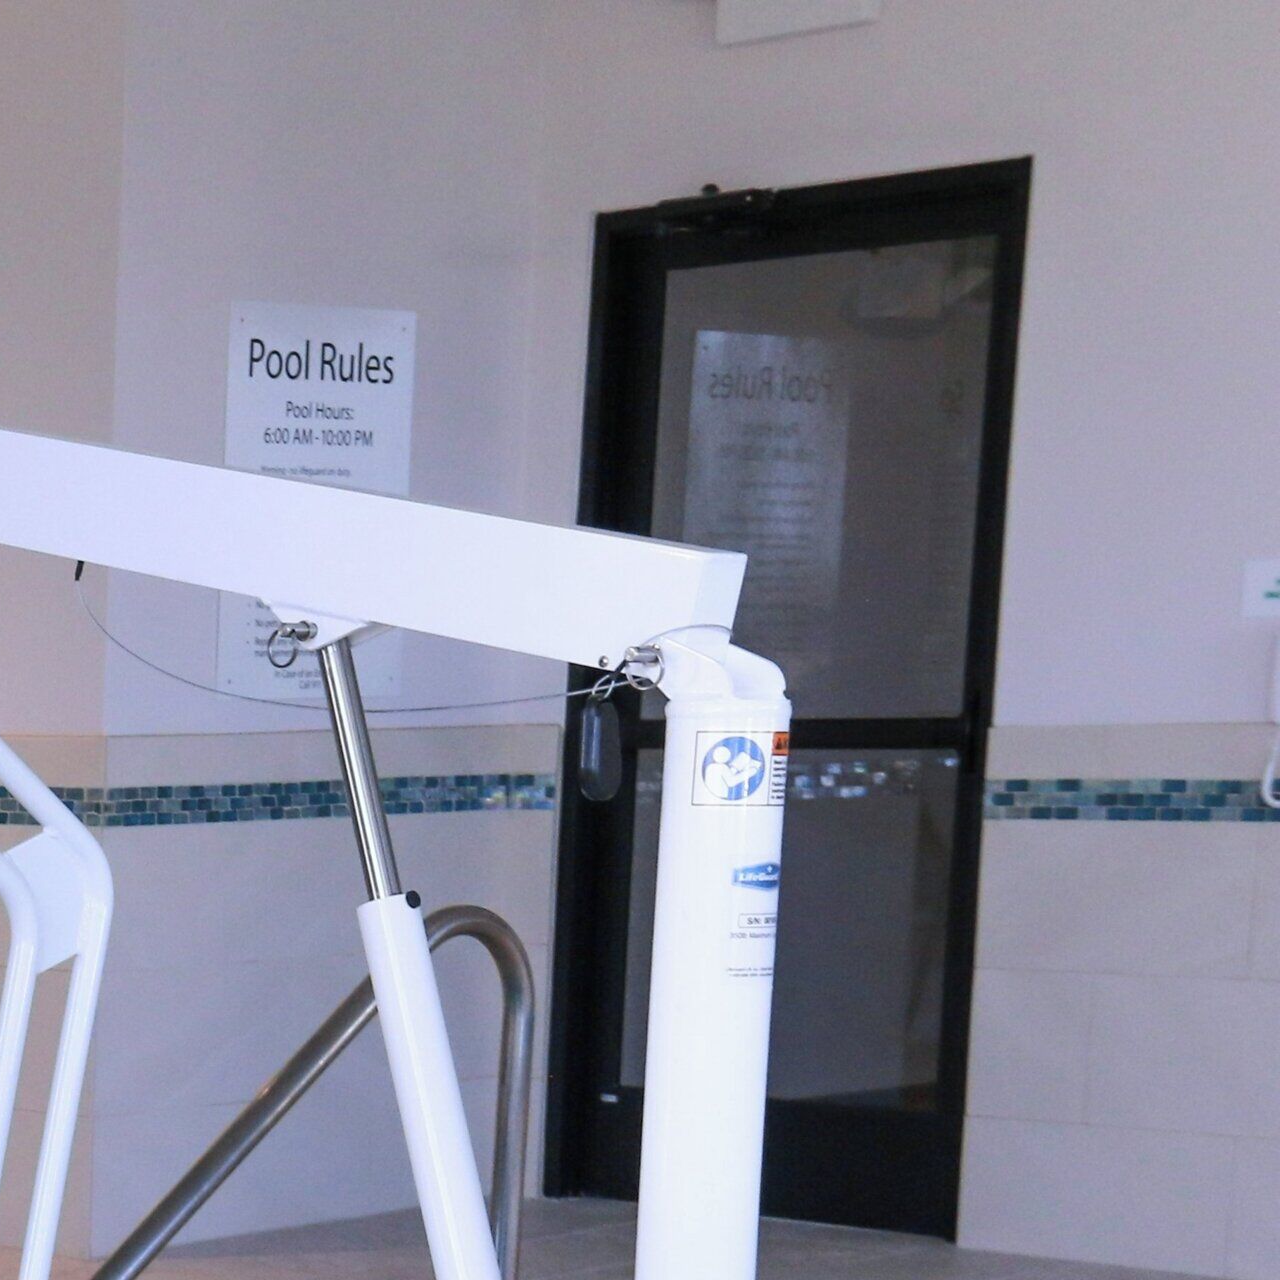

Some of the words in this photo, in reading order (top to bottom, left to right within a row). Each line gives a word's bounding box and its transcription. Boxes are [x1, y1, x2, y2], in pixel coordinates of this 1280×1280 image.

[249, 338, 310, 380] Pool
[320, 342, 394, 384] Rules
[286, 401, 312, 418] Pool
[315, 403, 354, 420] Hours:
[264, 427, 290, 445] 6:00
[292, 428, 313, 445] AM
[322, 430, 352, 446] 10:00
[354, 431, 373, 447] PM
